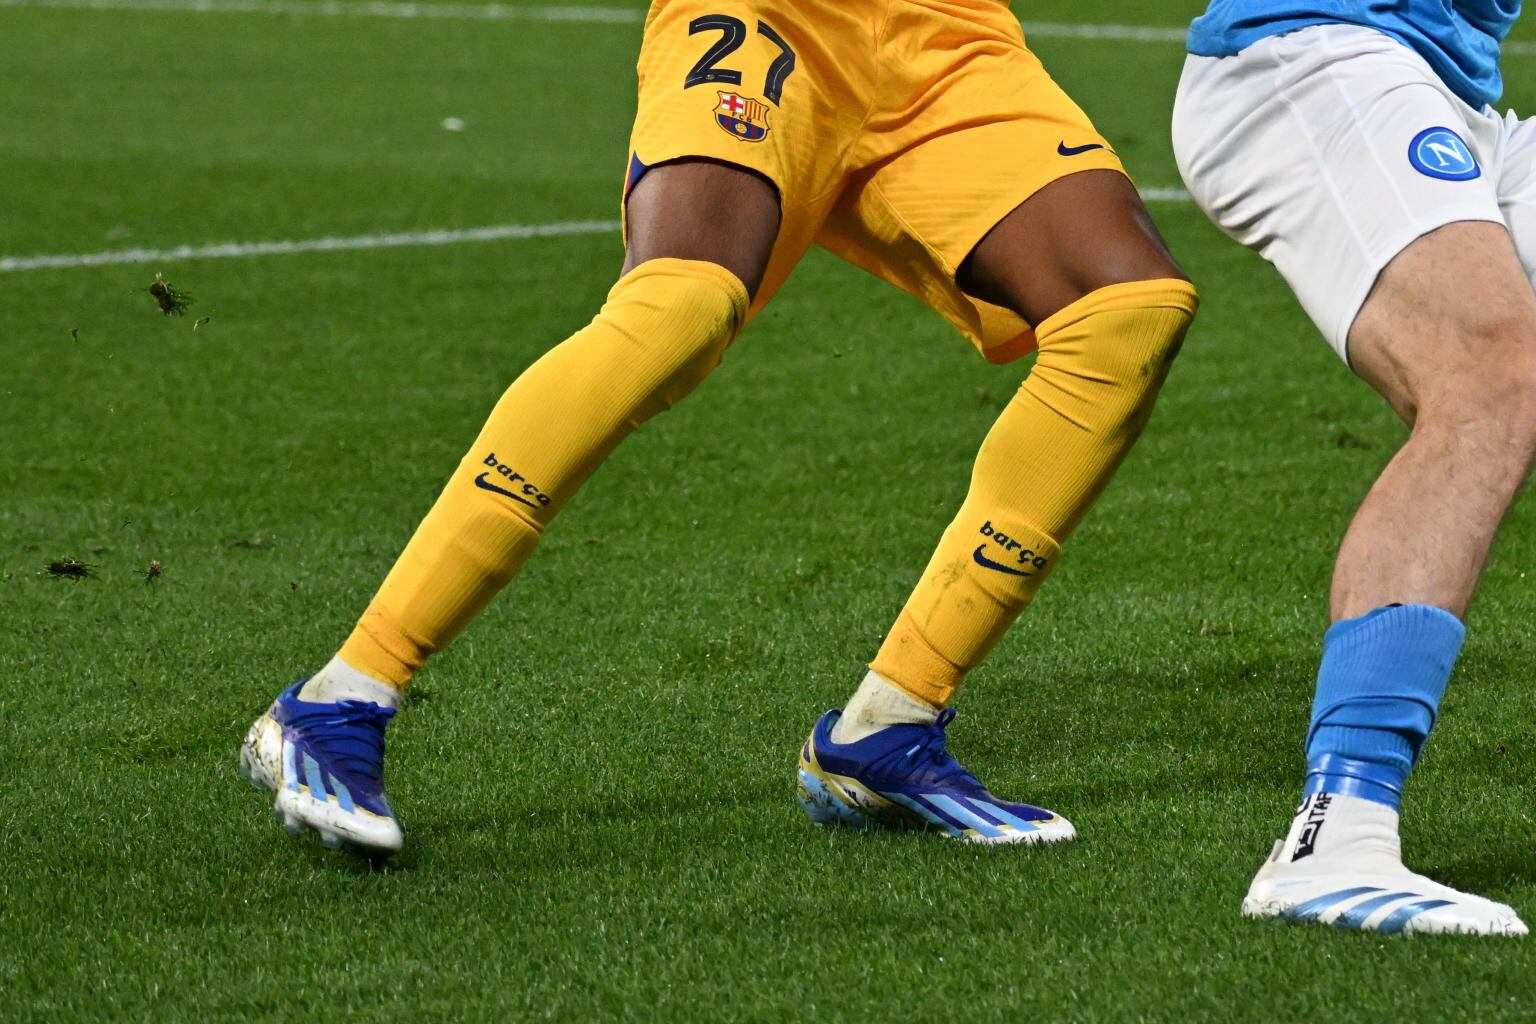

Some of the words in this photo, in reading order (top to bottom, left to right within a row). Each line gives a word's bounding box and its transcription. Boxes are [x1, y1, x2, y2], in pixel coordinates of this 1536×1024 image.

[684, 14, 795, 108] 27
[483, 452, 552, 506] barça
[980, 521, 1048, 569] barça
